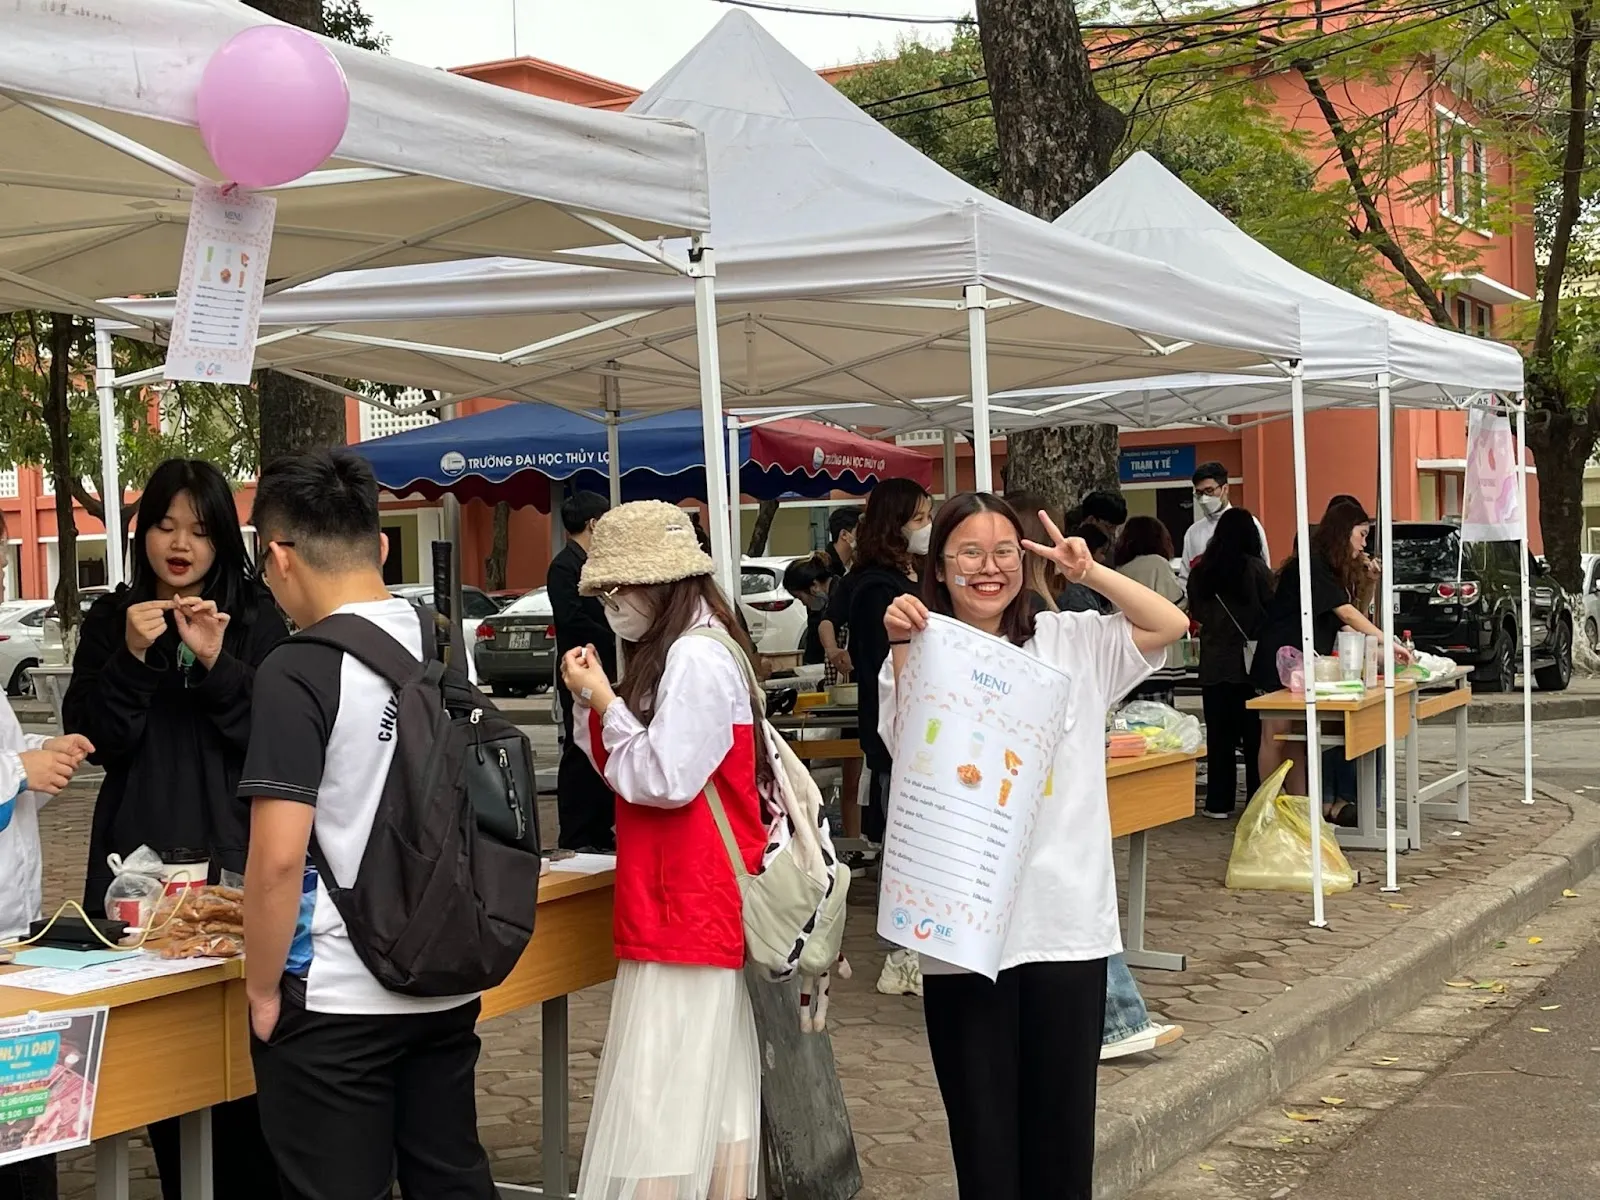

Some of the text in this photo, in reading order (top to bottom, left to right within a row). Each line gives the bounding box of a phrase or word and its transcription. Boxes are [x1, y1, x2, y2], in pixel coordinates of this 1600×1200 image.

[468, 455, 512, 469] TRƯỜNG
[516, 455, 536, 467] ĐẠI
[539, 453, 563, 467] HỌC
[565, 448, 594, 463] THỦY
[1131, 456, 1171, 472] TRẠM Y TẾ
[971, 669, 1012, 695] MENU
[935, 924, 954, 937] SIE
[31, 1039, 56, 1057] DAY
